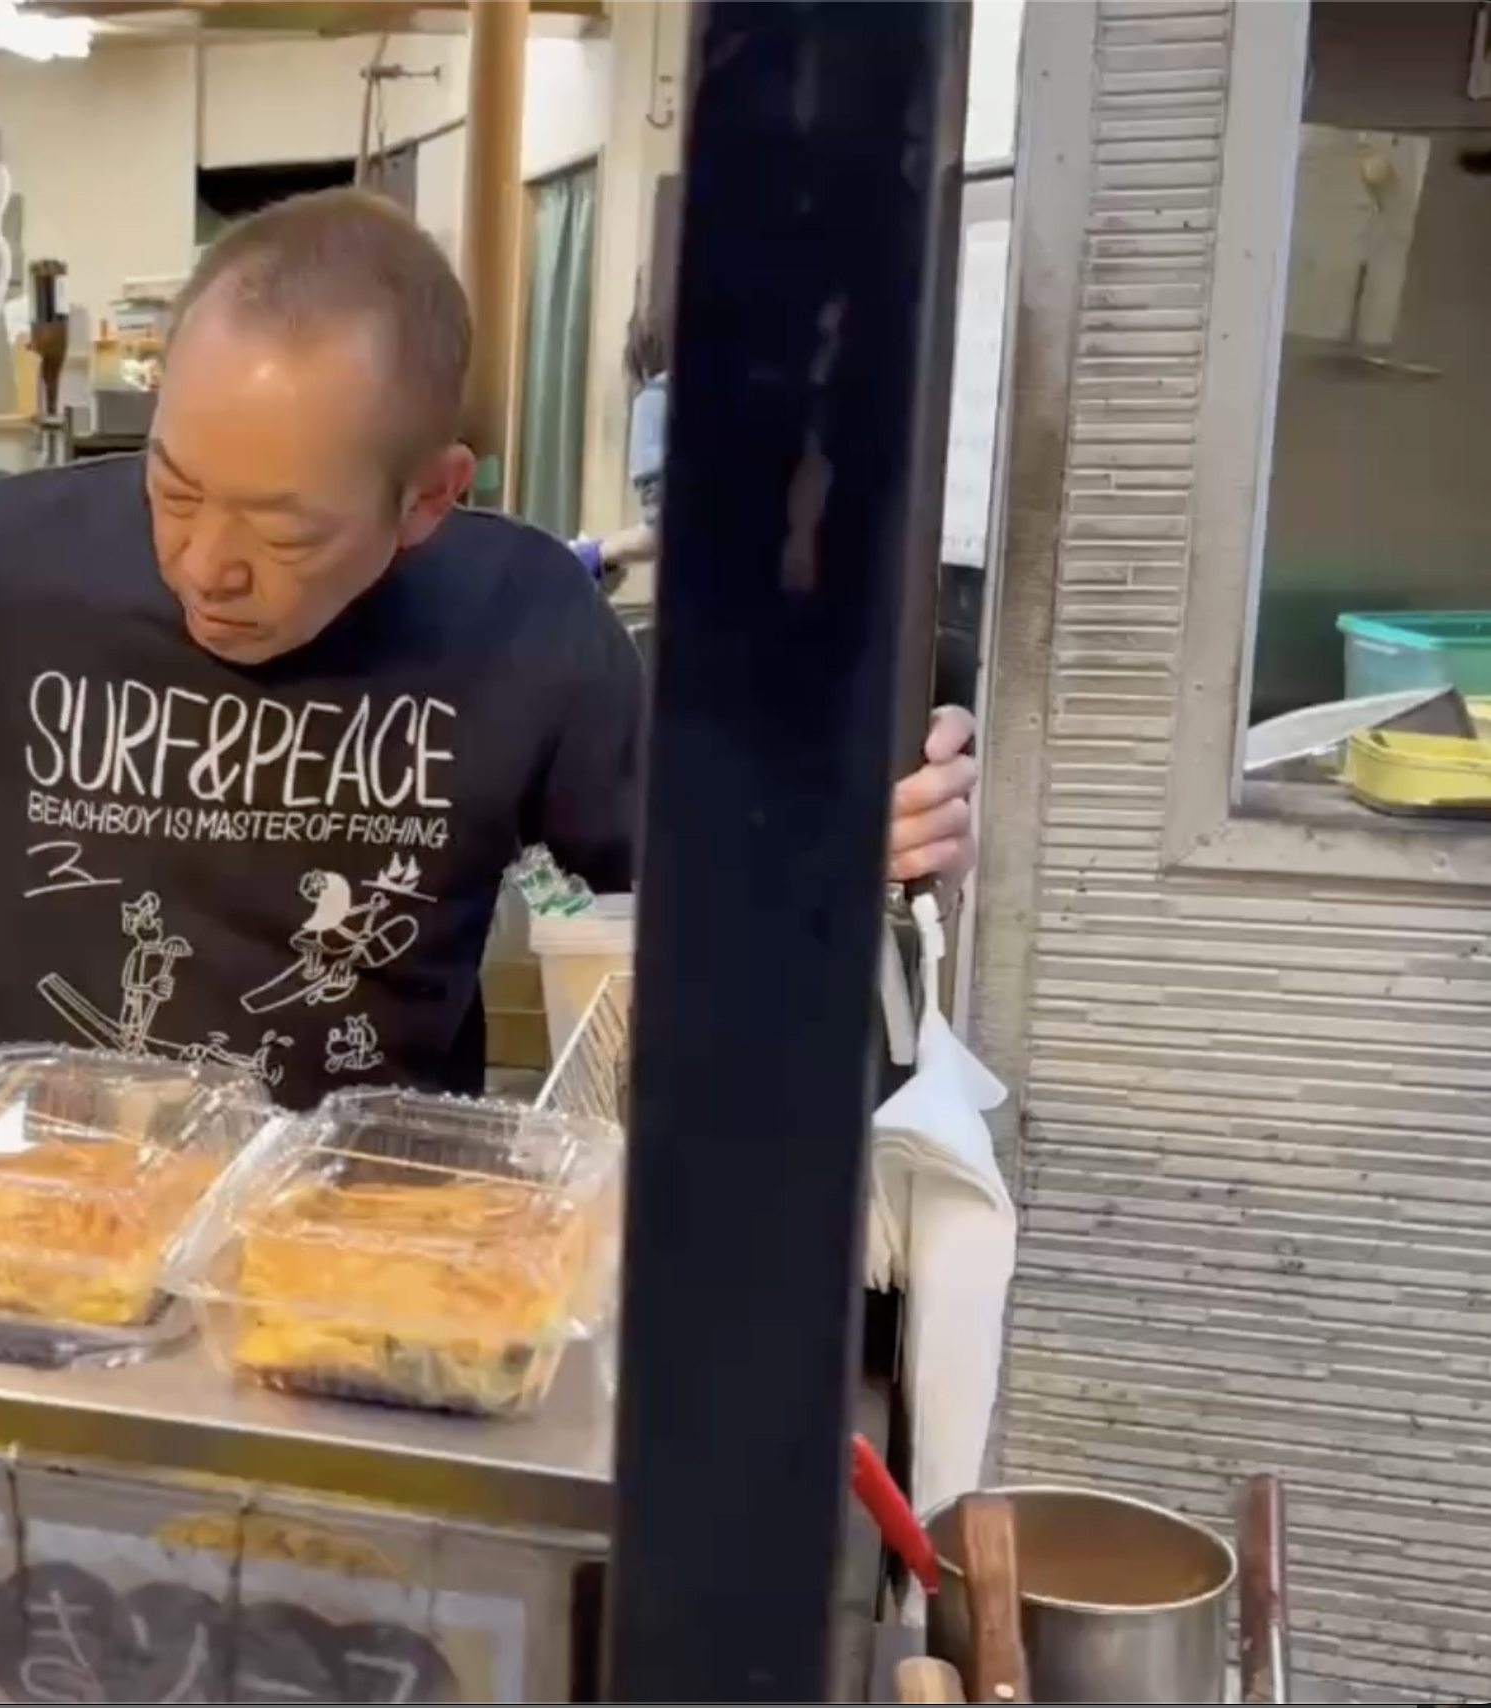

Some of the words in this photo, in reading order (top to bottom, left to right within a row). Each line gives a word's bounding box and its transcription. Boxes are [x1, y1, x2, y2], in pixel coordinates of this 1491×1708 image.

[26, 671, 457, 808] SURF&PEACE
[28, 791, 163, 837] BEACHBOY
[164, 807, 193, 840] IS
[194, 809, 306, 842] MASTER
[309, 814, 347, 842] OF
[347, 814, 450, 849] FISHING
